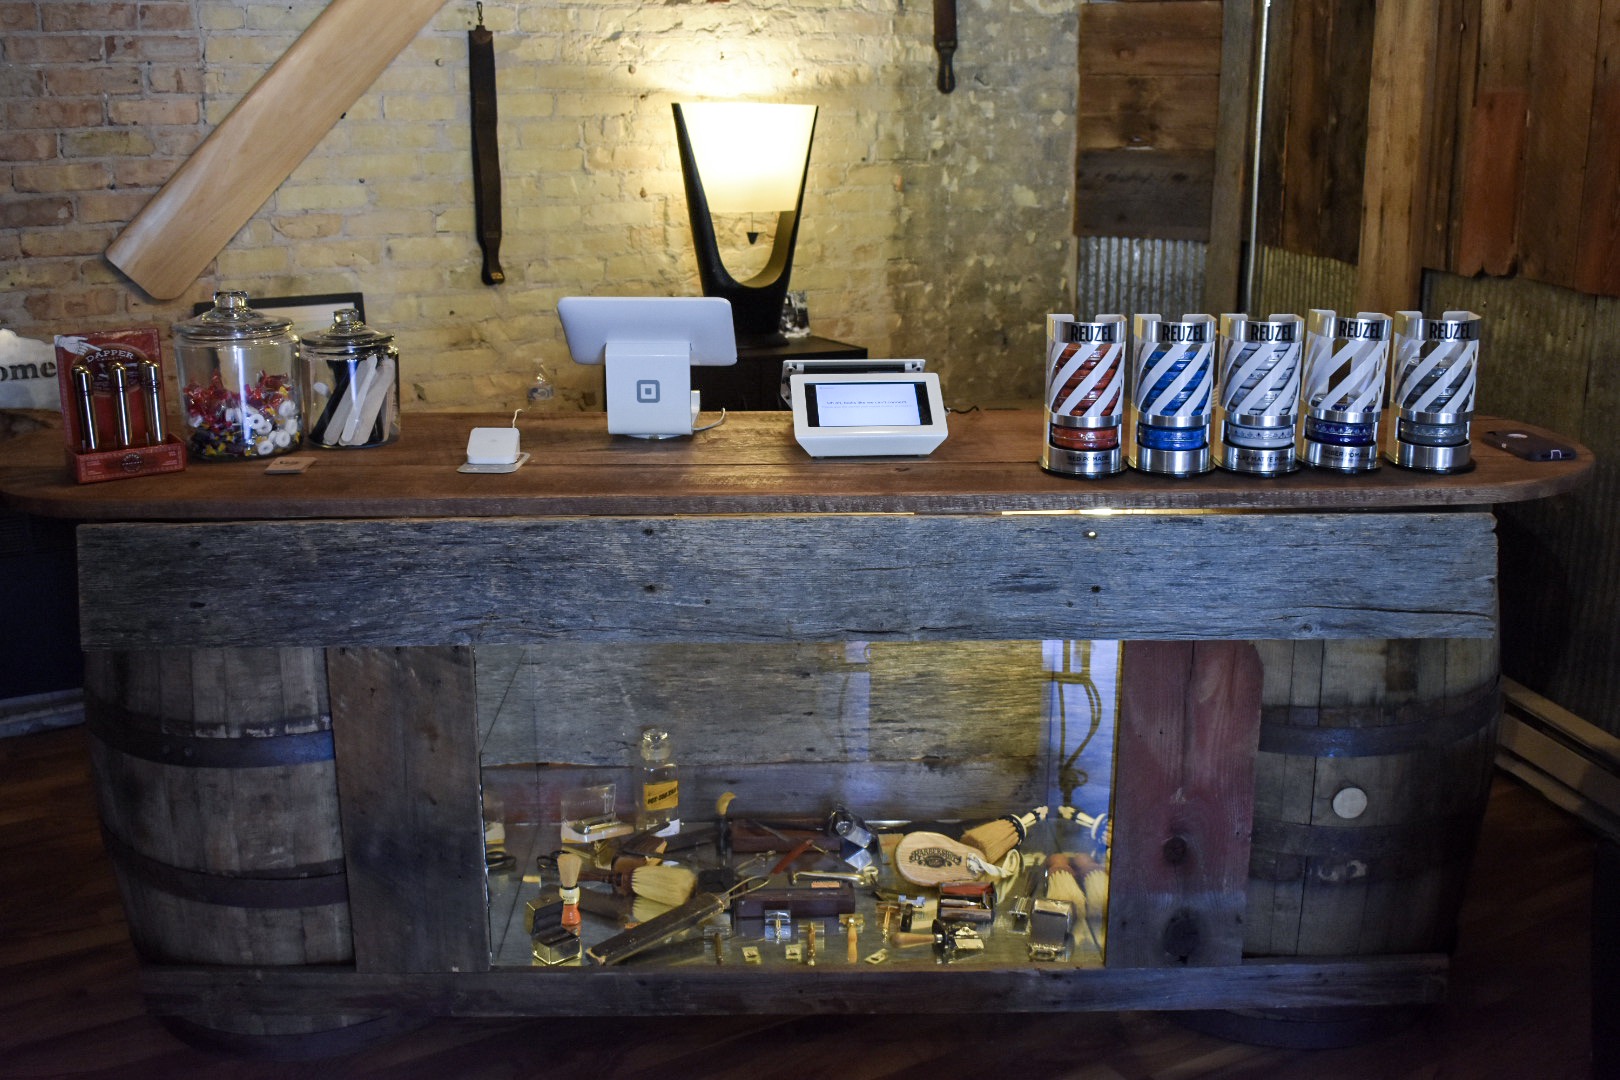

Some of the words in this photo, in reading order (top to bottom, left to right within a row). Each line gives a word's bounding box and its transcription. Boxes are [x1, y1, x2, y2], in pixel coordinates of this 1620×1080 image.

[1071, 325, 1113, 342] REUZEL
[1162, 325, 1204, 342] REUZEL
[1251, 324, 1293, 341] REUZEL
[1339, 321, 1381, 339] REUZEL
[1429, 322, 1471, 339] REUZEL
[85, 349, 134, 363] DAPPER
